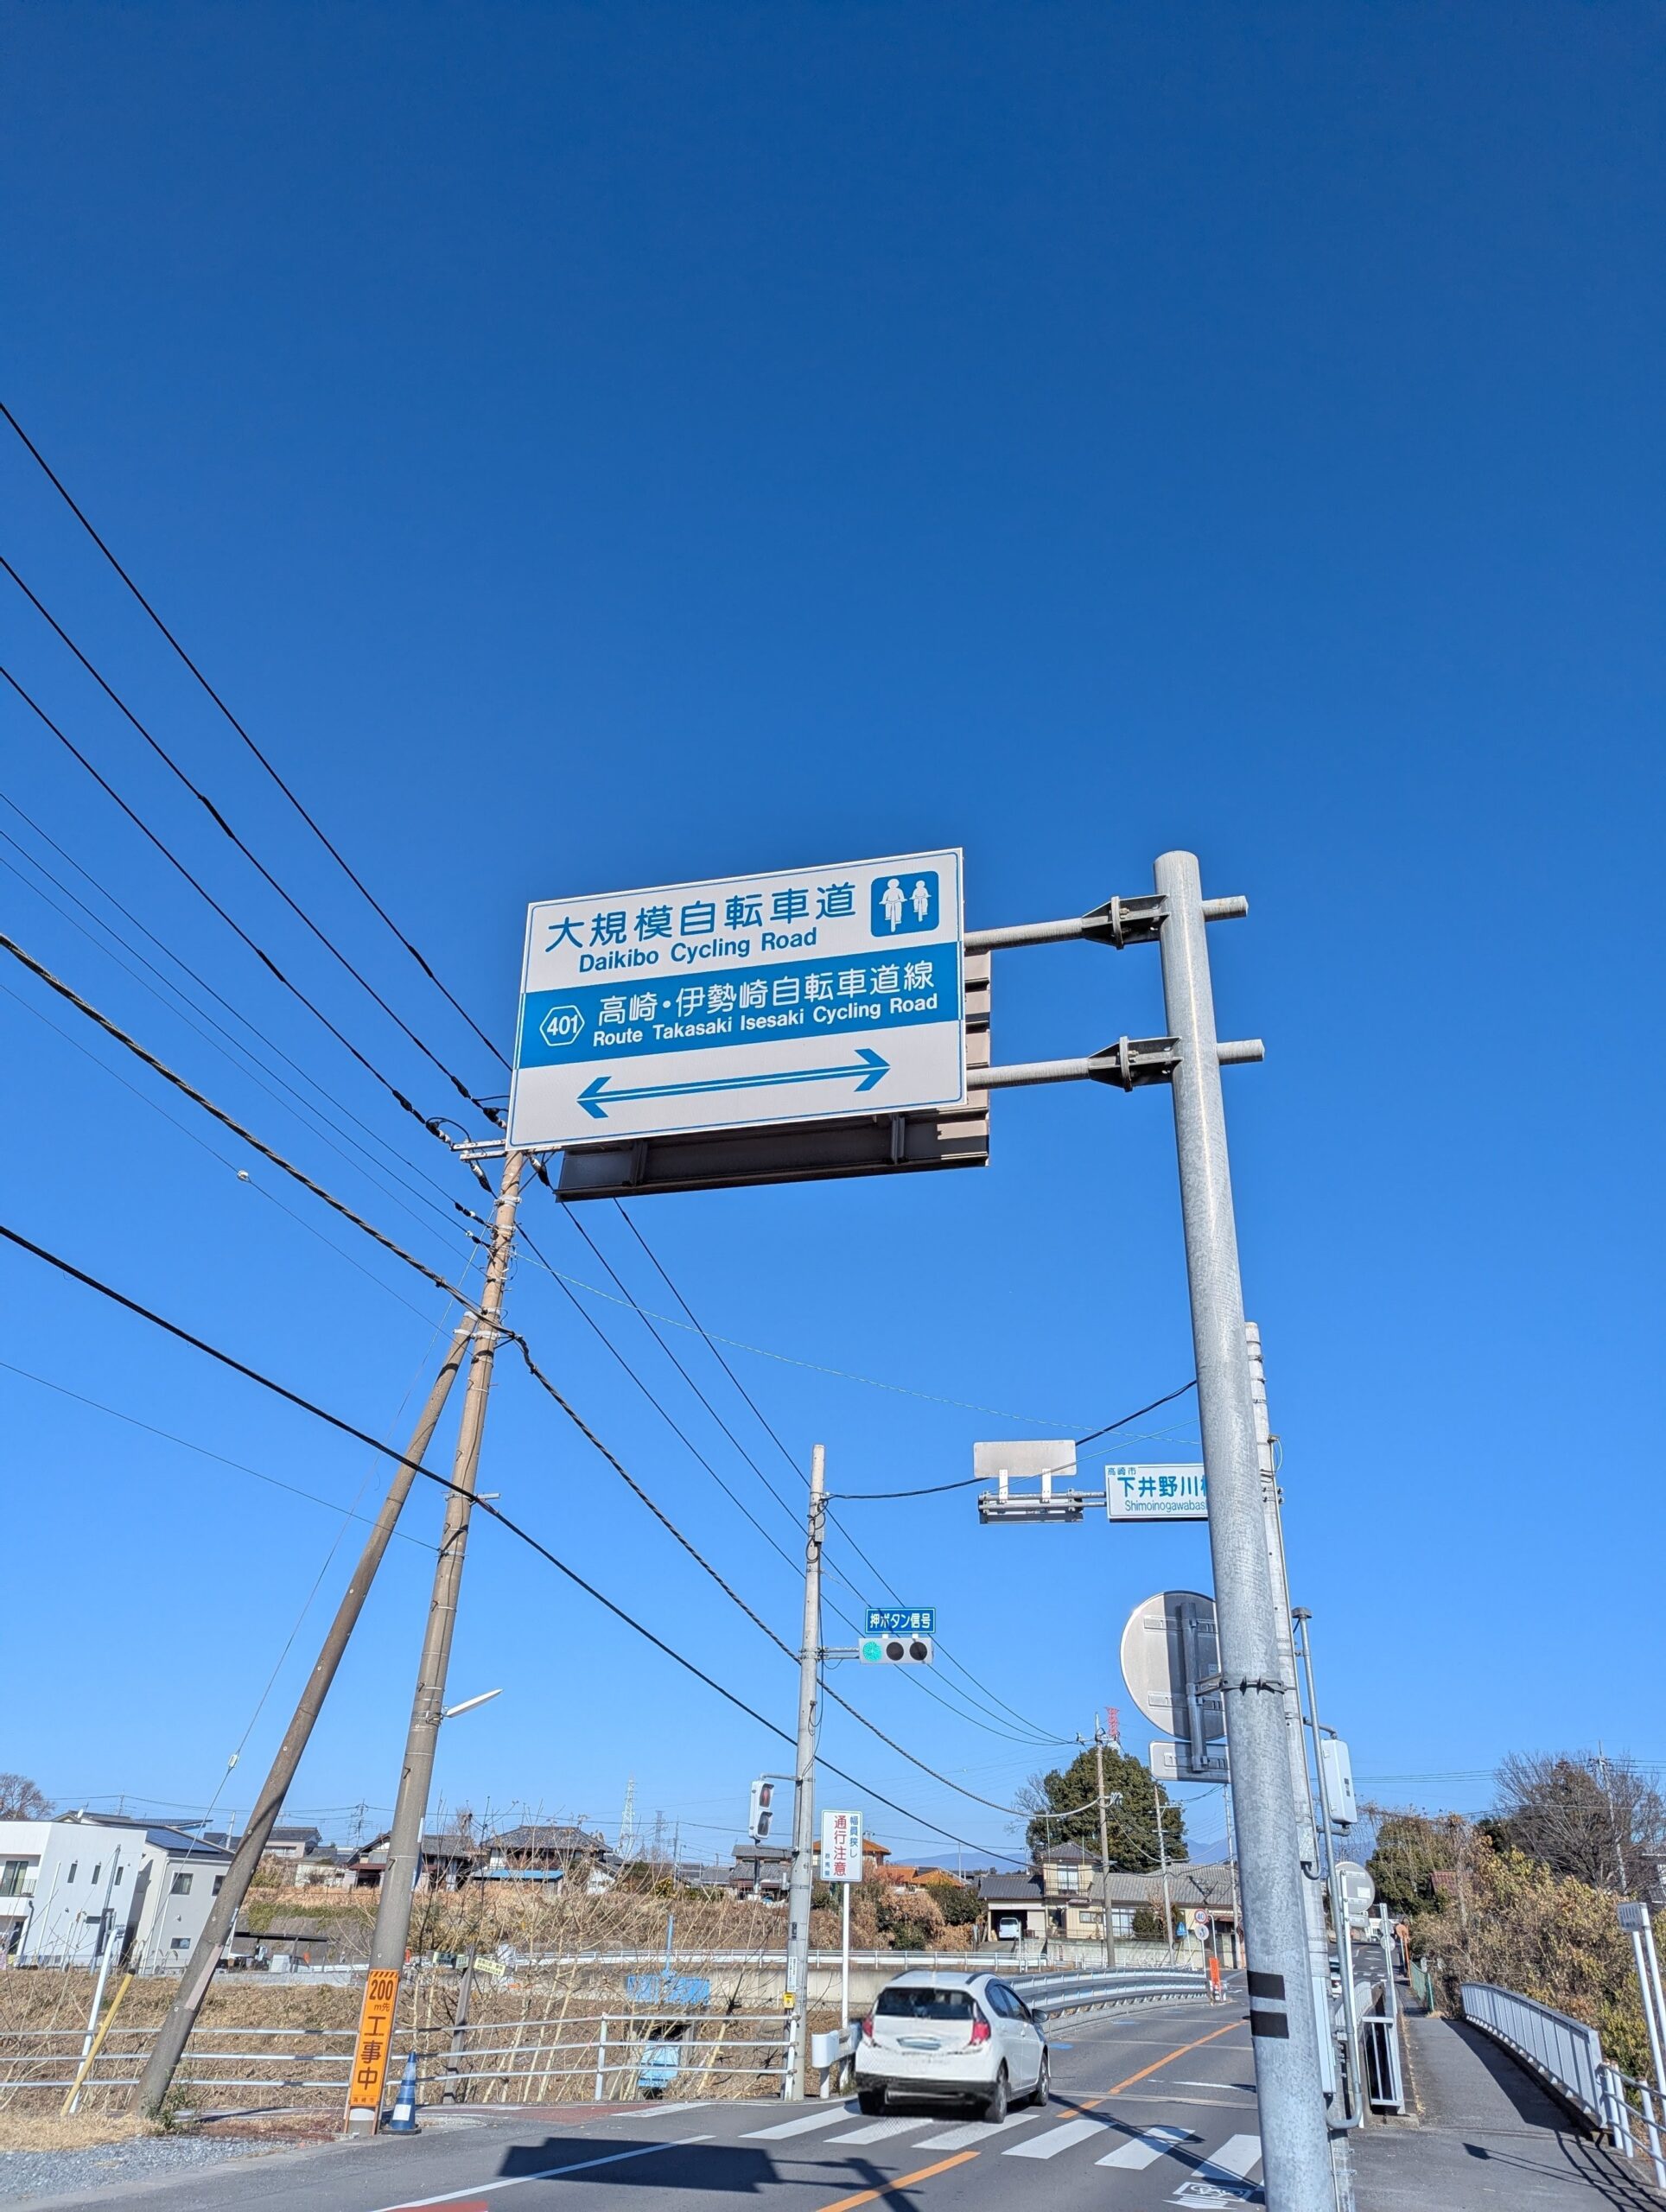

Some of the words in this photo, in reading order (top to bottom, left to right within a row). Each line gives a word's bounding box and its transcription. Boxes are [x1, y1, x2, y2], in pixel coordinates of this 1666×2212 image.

[544, 881, 856, 952] 大規模自転車道
[579, 948, 659, 973] Daikibo
[671, 935, 750, 963] Cycling
[761, 927, 817, 950] Road
[597, 960, 934, 1025] 高崎・伊勢崎自転車道線
[546, 1014, 578, 1036] 401
[593, 1027, 643, 1047] Route
[653, 1017, 732, 1039] Takasaki
[741, 1009, 804, 1032] Isesaki
[813, 1001, 881, 1026] Cycling
[889, 993, 938, 1014] Road
[869, 1612, 932, 1629] 押ボタン信号
[834, 1815, 847, 1876] 通行注意
[369, 1980, 394, 2001] 200
[357, 2016, 386, 2090] 工事中
